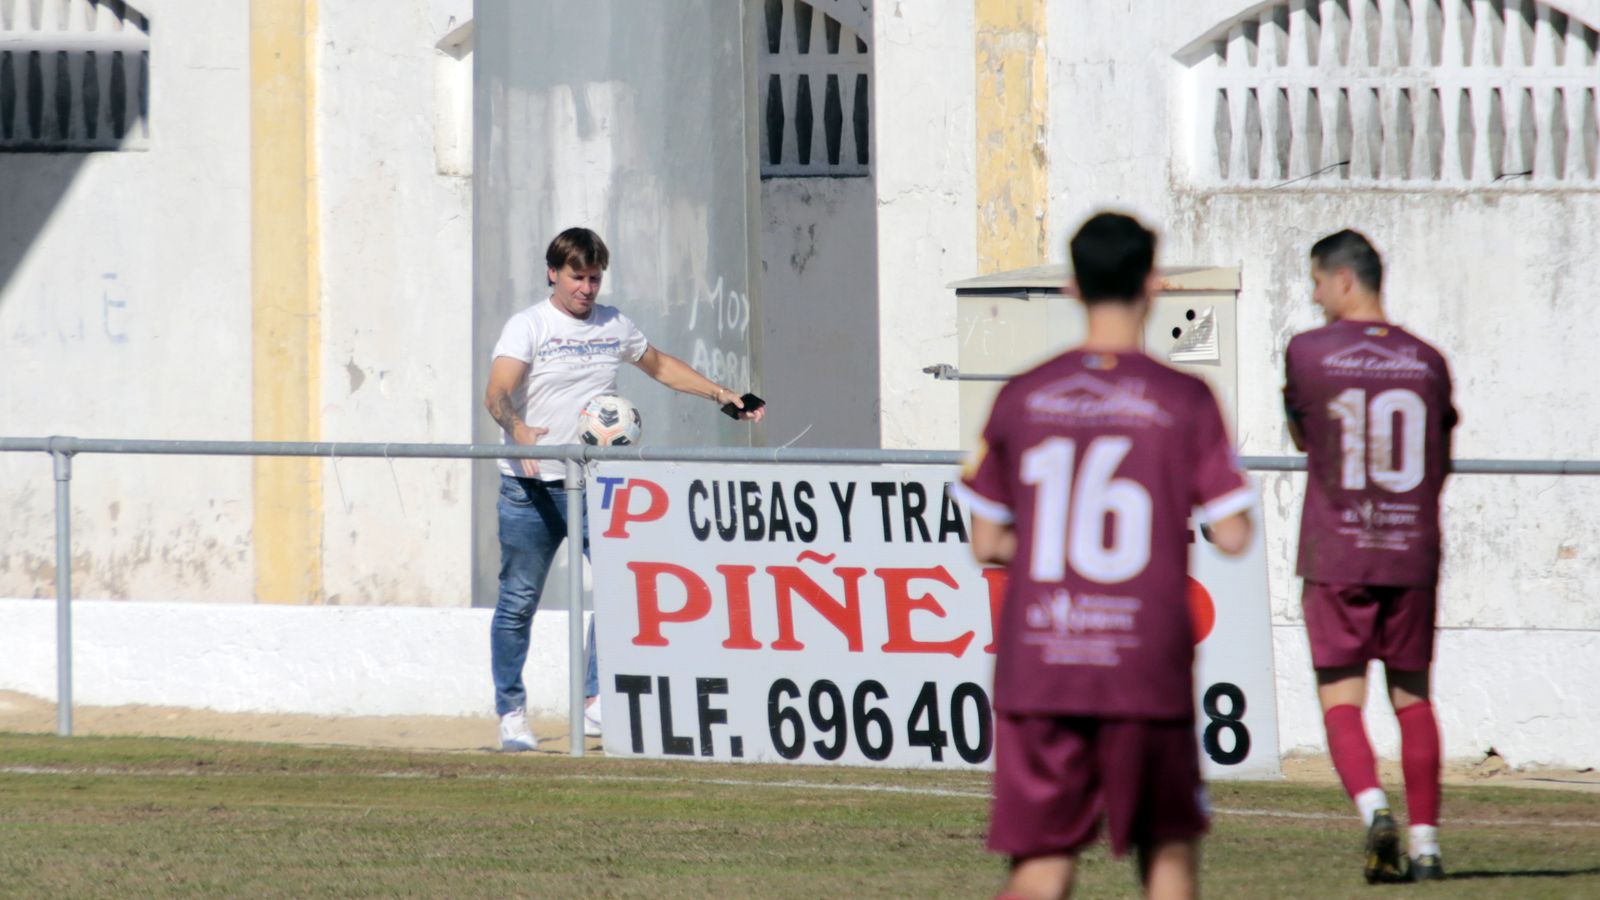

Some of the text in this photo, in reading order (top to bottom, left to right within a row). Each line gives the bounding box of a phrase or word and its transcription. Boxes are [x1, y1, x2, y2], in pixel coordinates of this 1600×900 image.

[1327, 387, 1427, 493] 10
[688, 479, 818, 543] CUBAS
[829, 481, 857, 543] Y
[1019, 435, 1153, 584] 16
[614, 674, 744, 758] TLF.
[767, 677, 894, 762] 696
